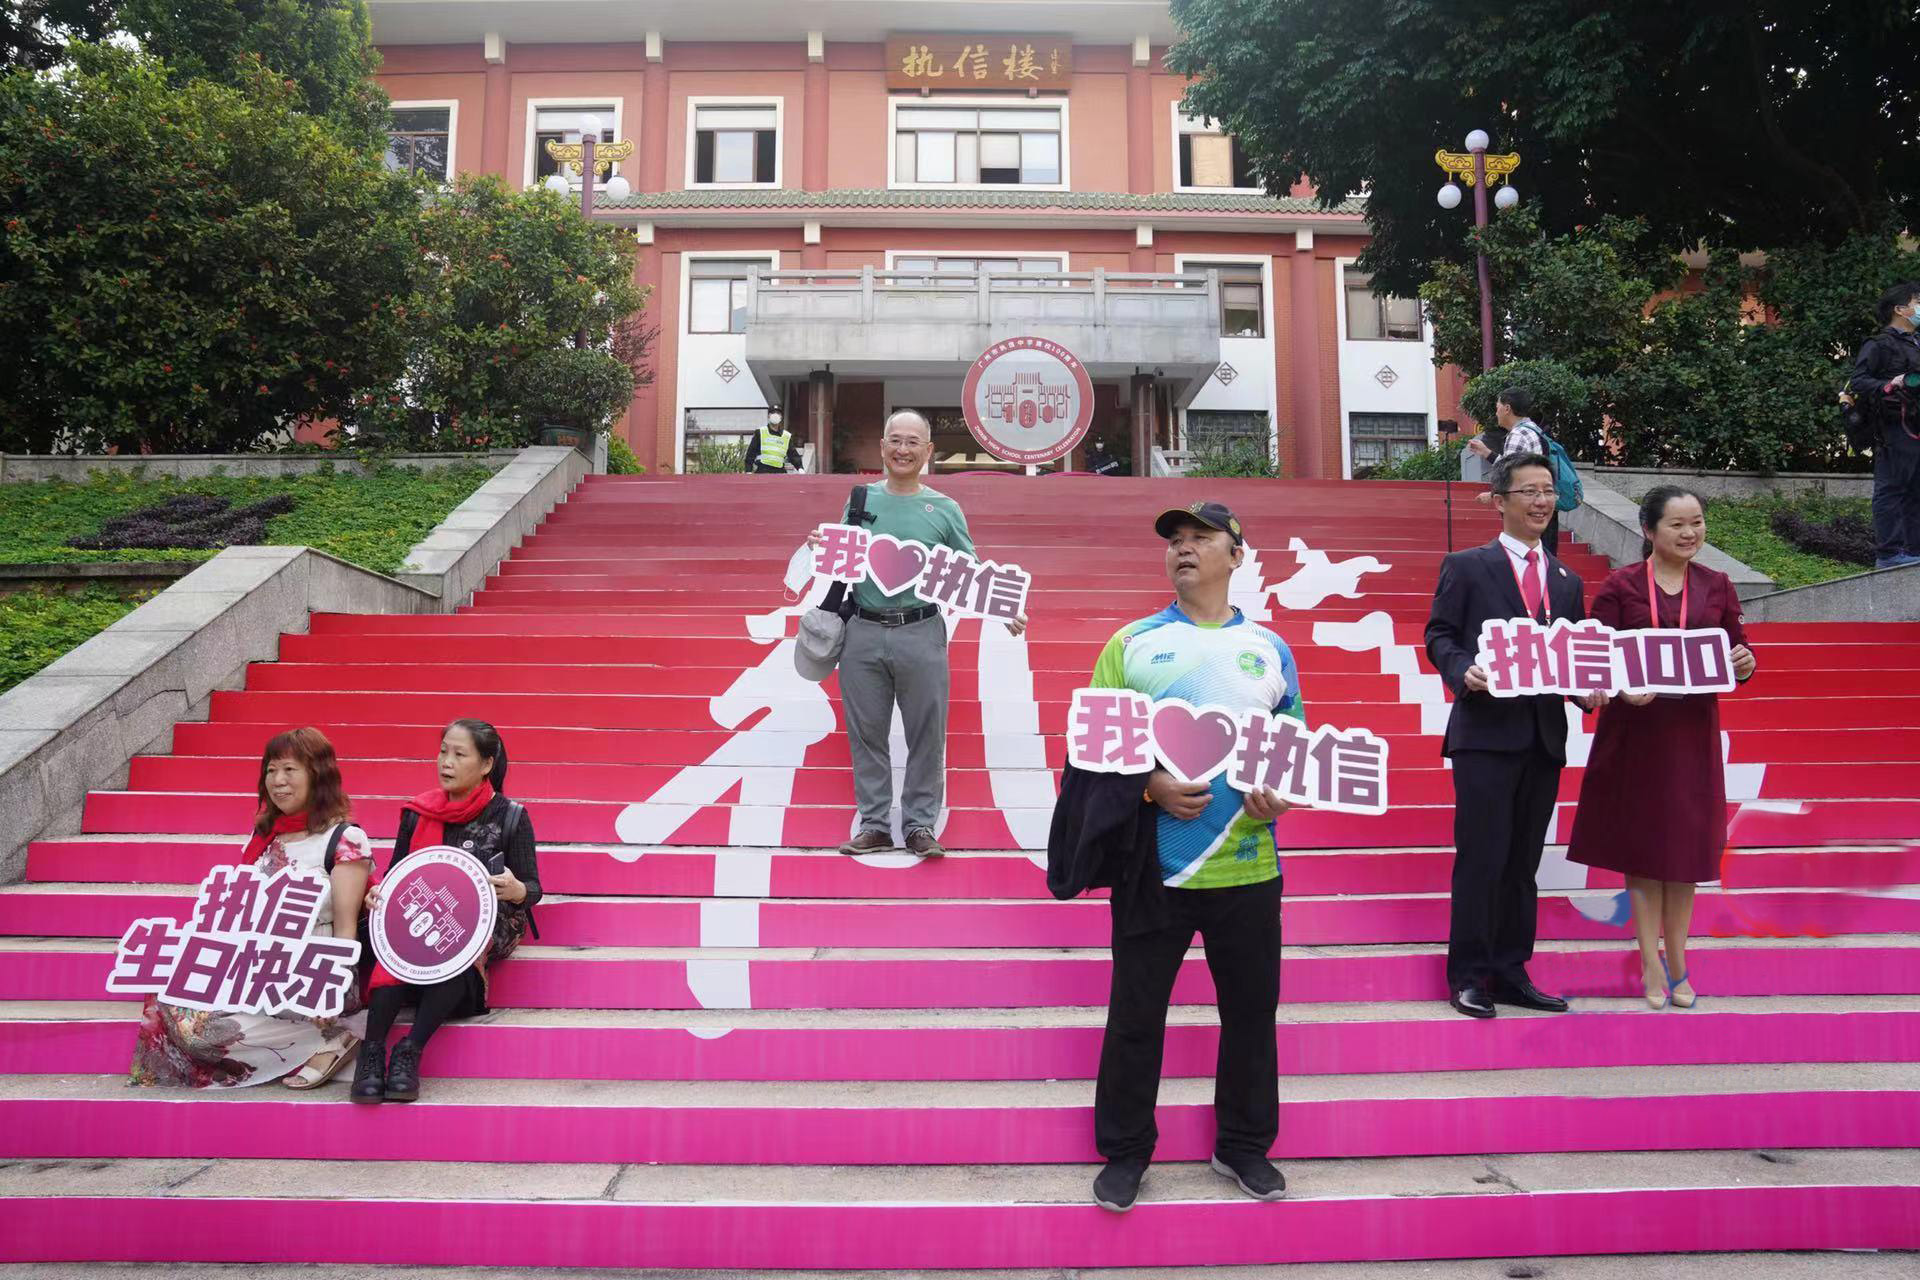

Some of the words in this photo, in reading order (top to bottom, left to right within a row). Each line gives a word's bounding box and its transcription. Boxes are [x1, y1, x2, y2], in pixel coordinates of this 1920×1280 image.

[902, 44, 1044, 81] 执信楼
[1001, 448, 1022, 460] SCHOOL
[1024, 450, 1054, 460] CENTENARY
[815, 527, 868, 579] 我
[919, 549, 1027, 619] 执信
[1074, 695, 1149, 765] 我
[1235, 714, 1381, 807] 执信
[195, 871, 324, 940] 执信
[112, 923, 355, 1011] 生日快乐
